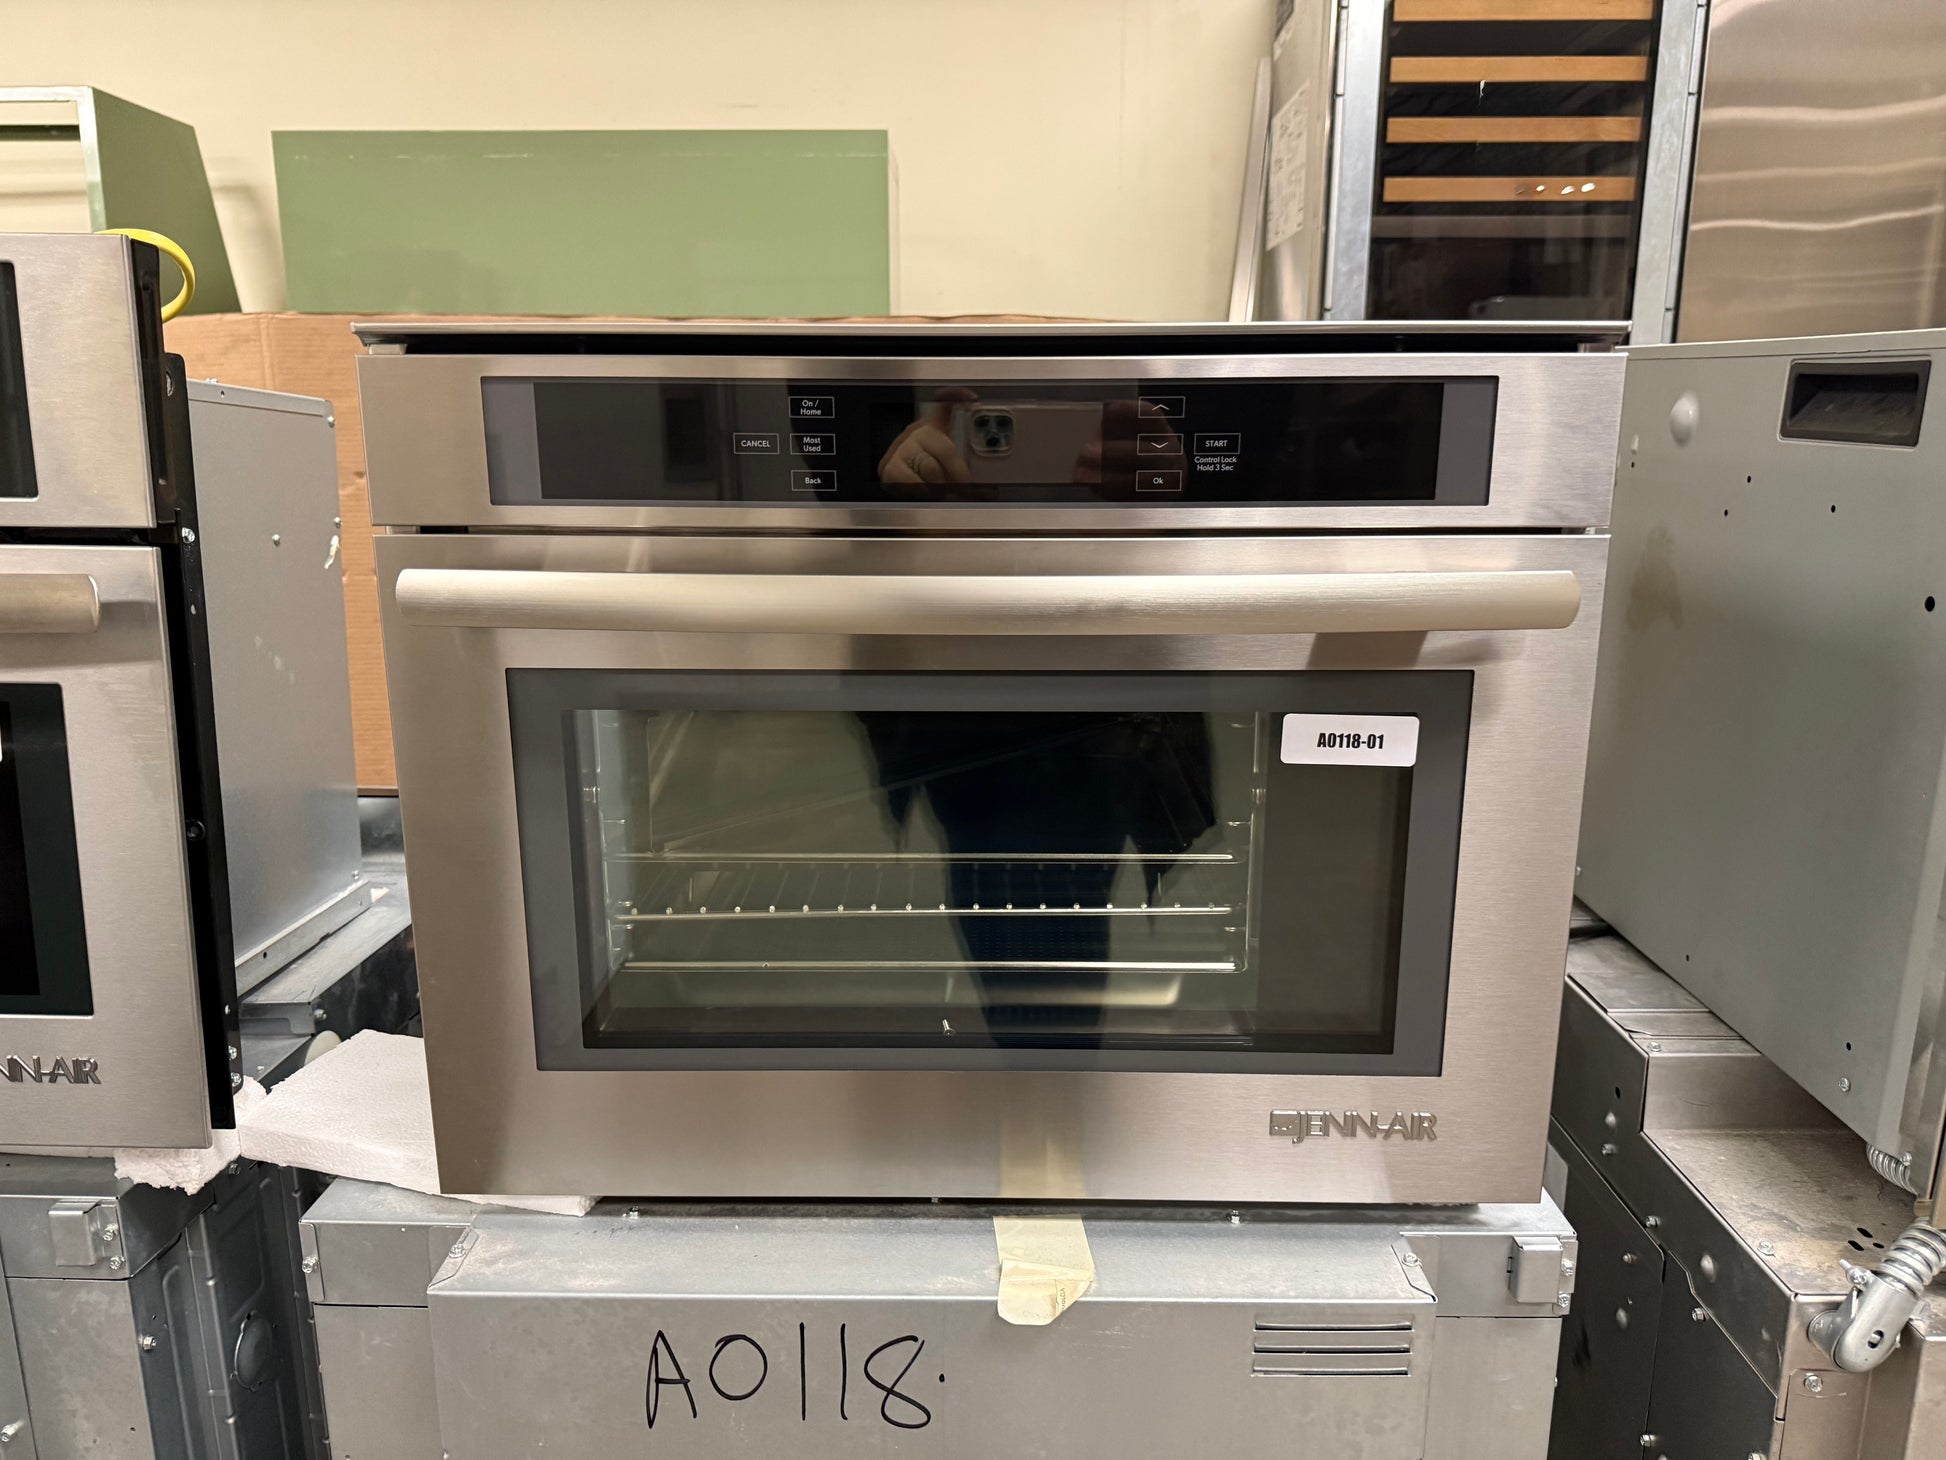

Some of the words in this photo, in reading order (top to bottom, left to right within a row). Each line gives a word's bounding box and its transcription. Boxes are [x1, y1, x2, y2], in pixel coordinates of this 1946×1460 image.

[800, 408, 822, 416] Home
[741, 440, 770, 448] CANCEL
[1205, 440, 1228, 448] START
[1194, 456, 1220, 464] Control
[1153, 477, 1163, 485] Ok
[1317, 733, 1384, 749] A0118-01
[1292, 1110, 1437, 1144] JENN-AIR
